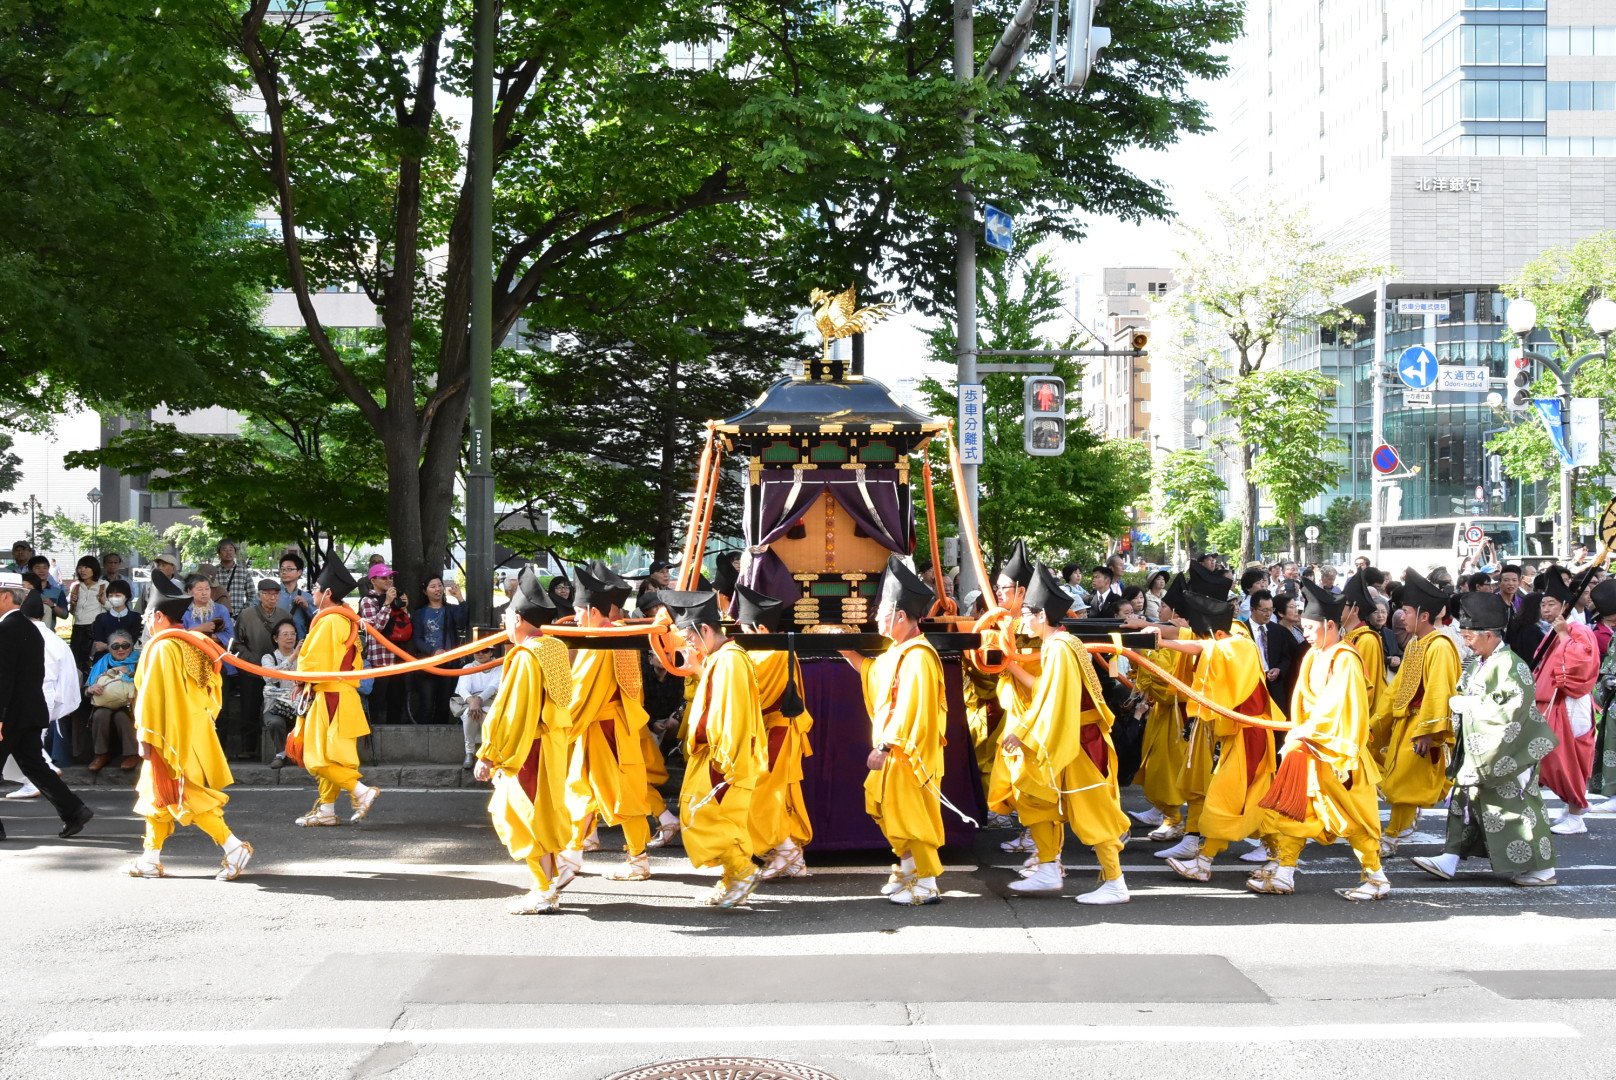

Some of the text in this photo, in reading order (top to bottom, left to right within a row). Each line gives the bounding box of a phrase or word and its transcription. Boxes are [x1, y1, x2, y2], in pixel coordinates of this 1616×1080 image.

[1416, 176, 1482, 192] 北洋銀行
[1443, 370, 1485, 381] 大通西4
[964, 389, 978, 460] 歩車分離式
